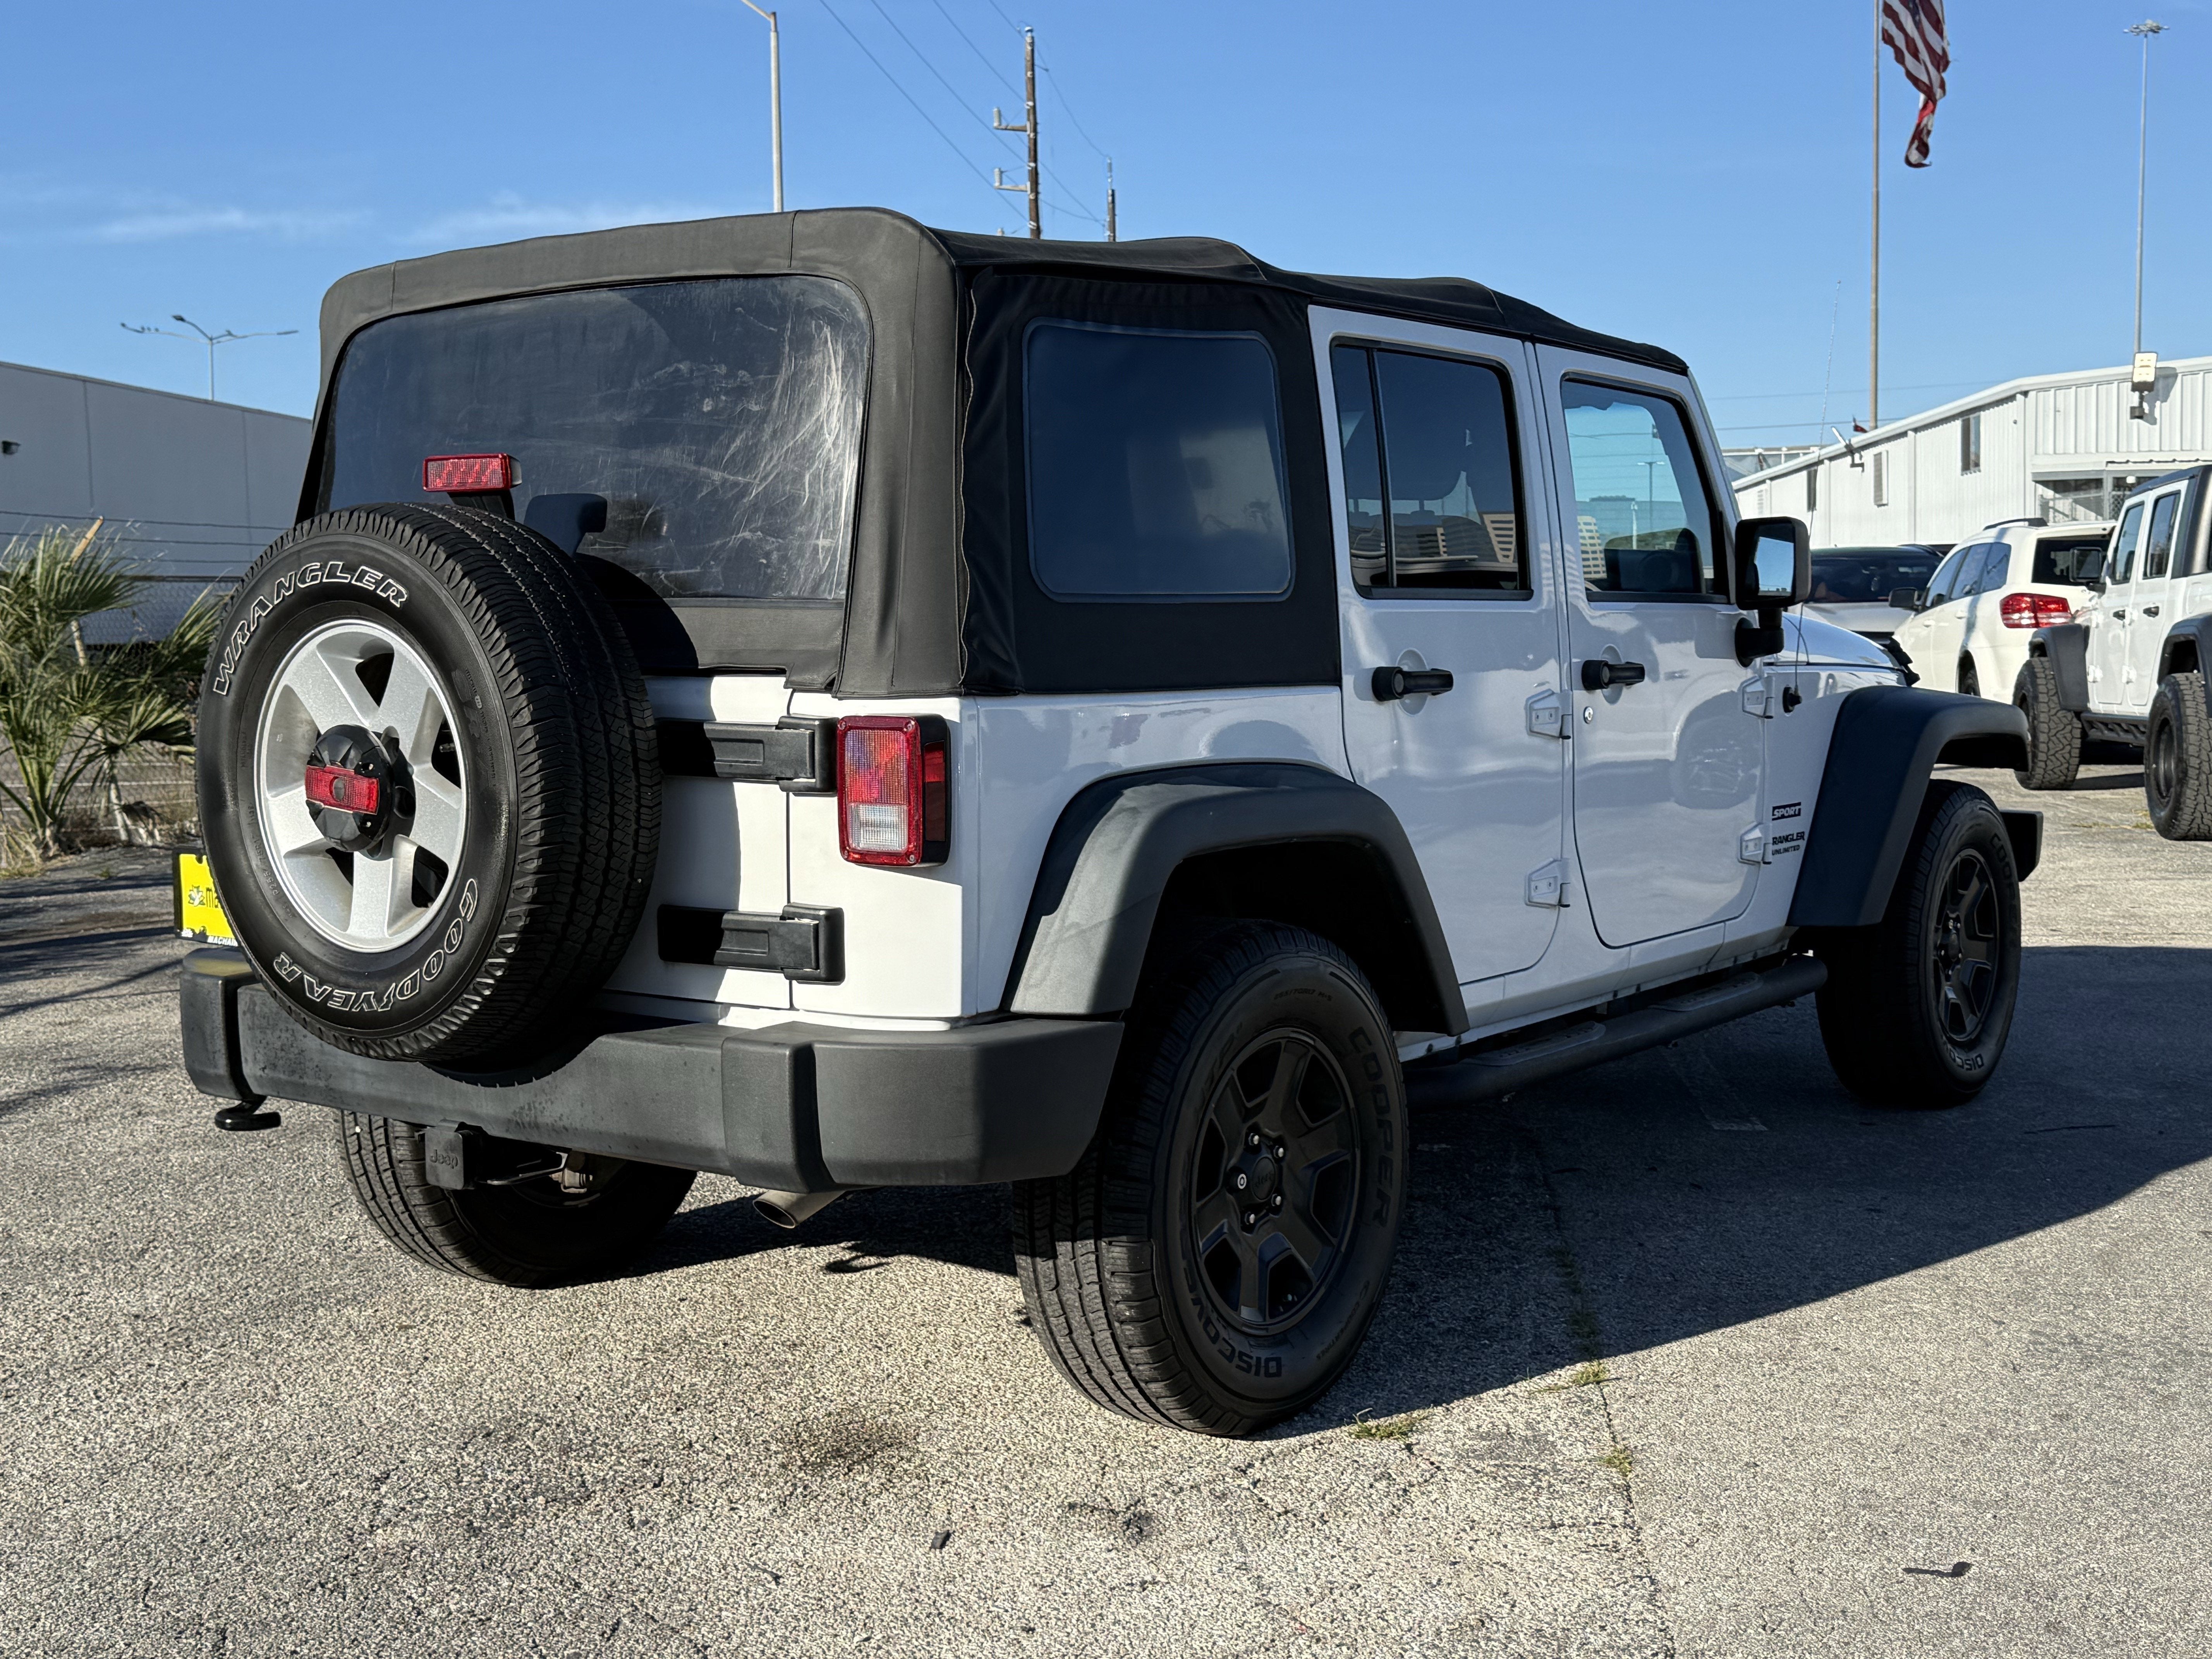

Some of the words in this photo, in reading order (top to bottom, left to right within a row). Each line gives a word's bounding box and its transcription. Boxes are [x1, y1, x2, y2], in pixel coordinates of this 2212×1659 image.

[213, 561, 408, 695] WRANGLER
[1772, 805, 1801, 818] SPORT
[1772, 831, 1805, 846] RANGLER
[1772, 844, 1801, 856] UNLIMITED
[273, 878, 478, 1012] GOODYEAR
[1348, 1026, 1393, 1228] COOPER
[429, 1149, 459, 1170] Jeep
